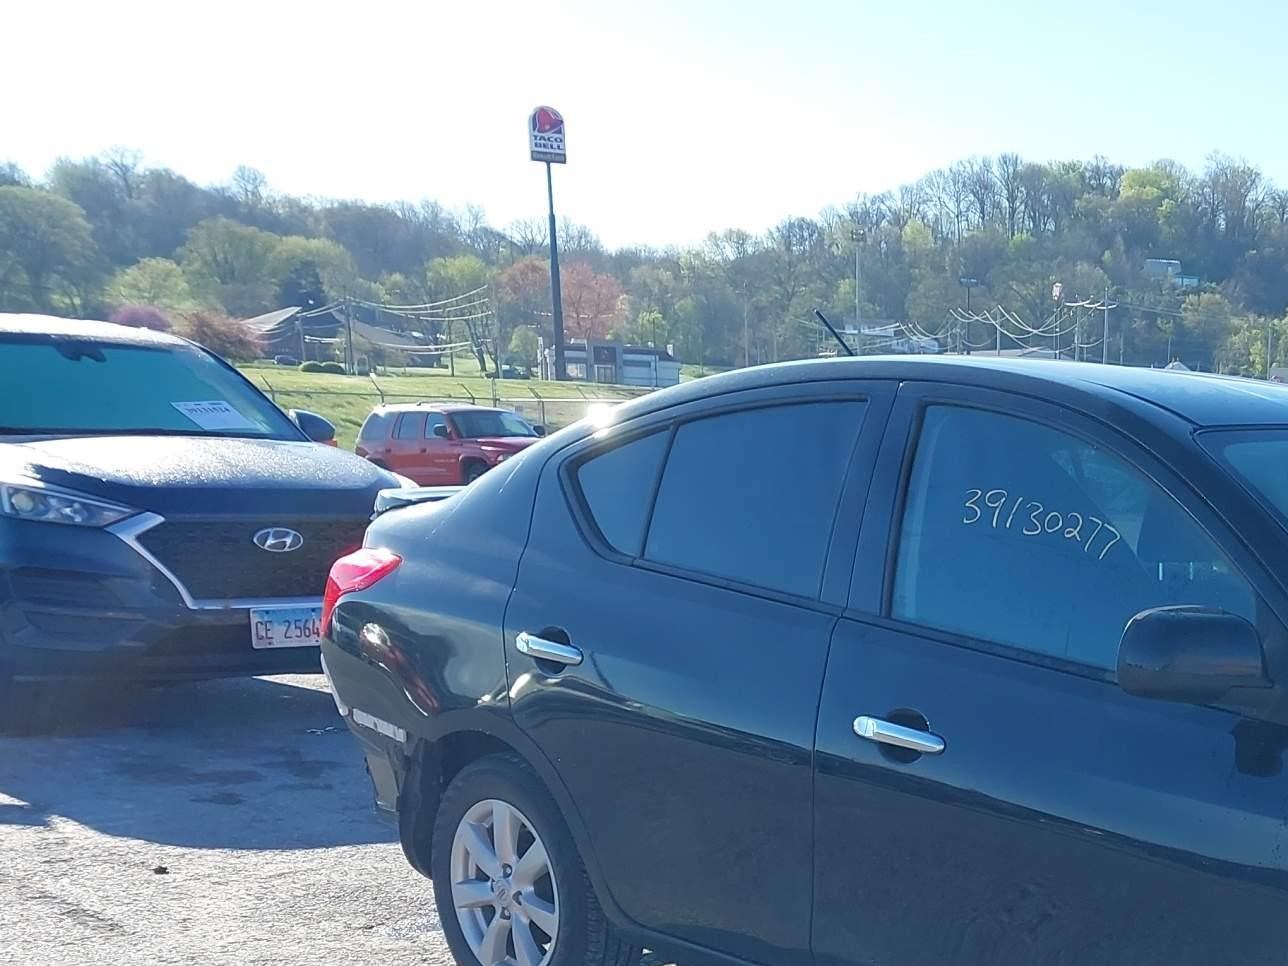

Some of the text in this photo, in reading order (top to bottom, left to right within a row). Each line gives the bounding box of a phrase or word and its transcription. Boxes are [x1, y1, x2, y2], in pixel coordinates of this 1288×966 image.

[533, 135, 563, 143] TACO
[534, 142, 565, 150] BELL
[963, 489, 1121, 560] 39130277
[255, 618, 322, 640] CE 2564
